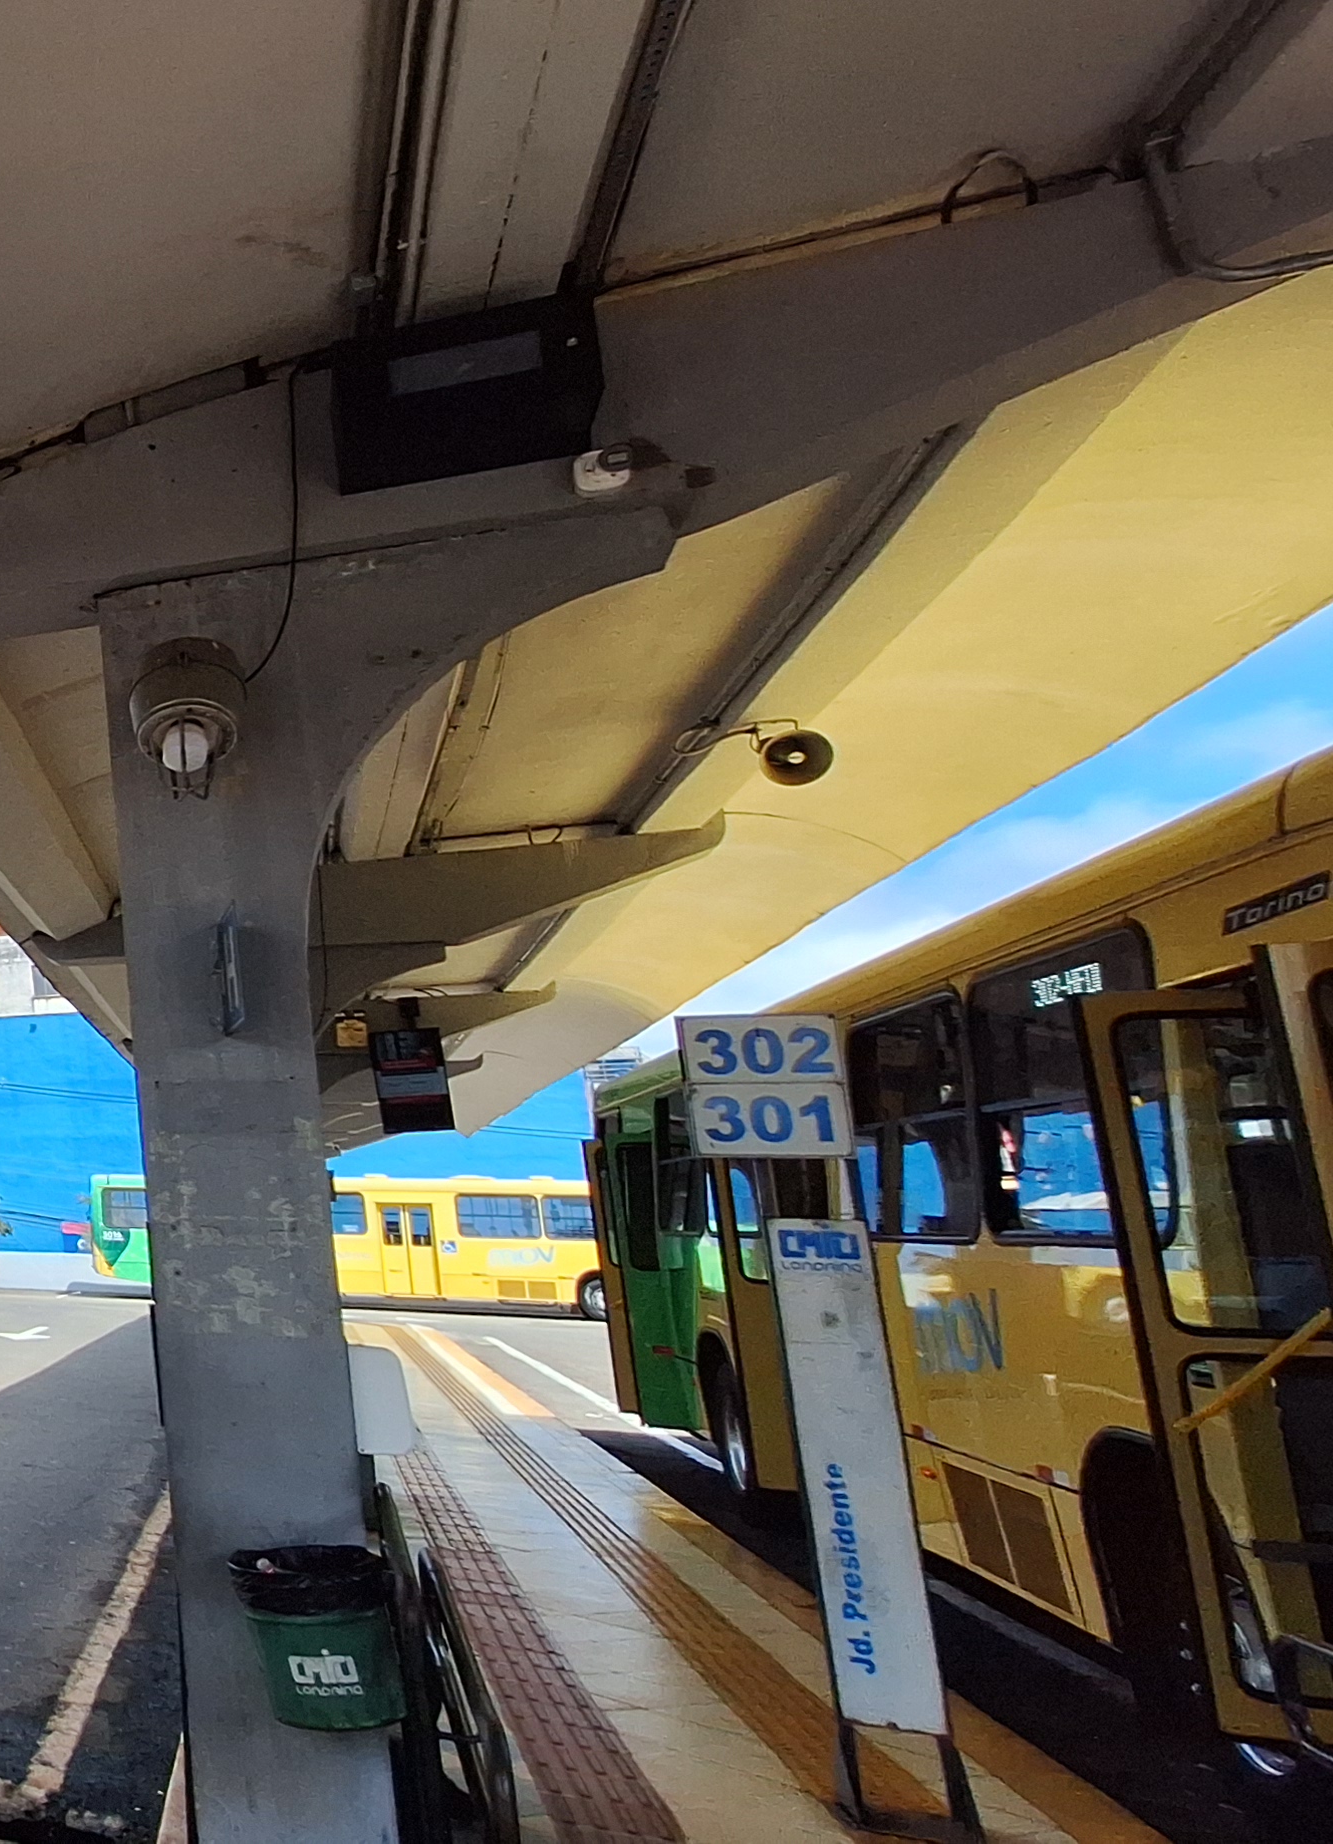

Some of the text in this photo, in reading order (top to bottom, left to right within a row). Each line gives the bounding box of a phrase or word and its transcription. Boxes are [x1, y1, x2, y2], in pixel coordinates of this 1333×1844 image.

[1226, 884, 1325, 931] Torino
[694, 1027, 836, 1075] 302
[702, 1095, 835, 1143] 301
[823, 1462, 877, 1676] Jd. Presidente
